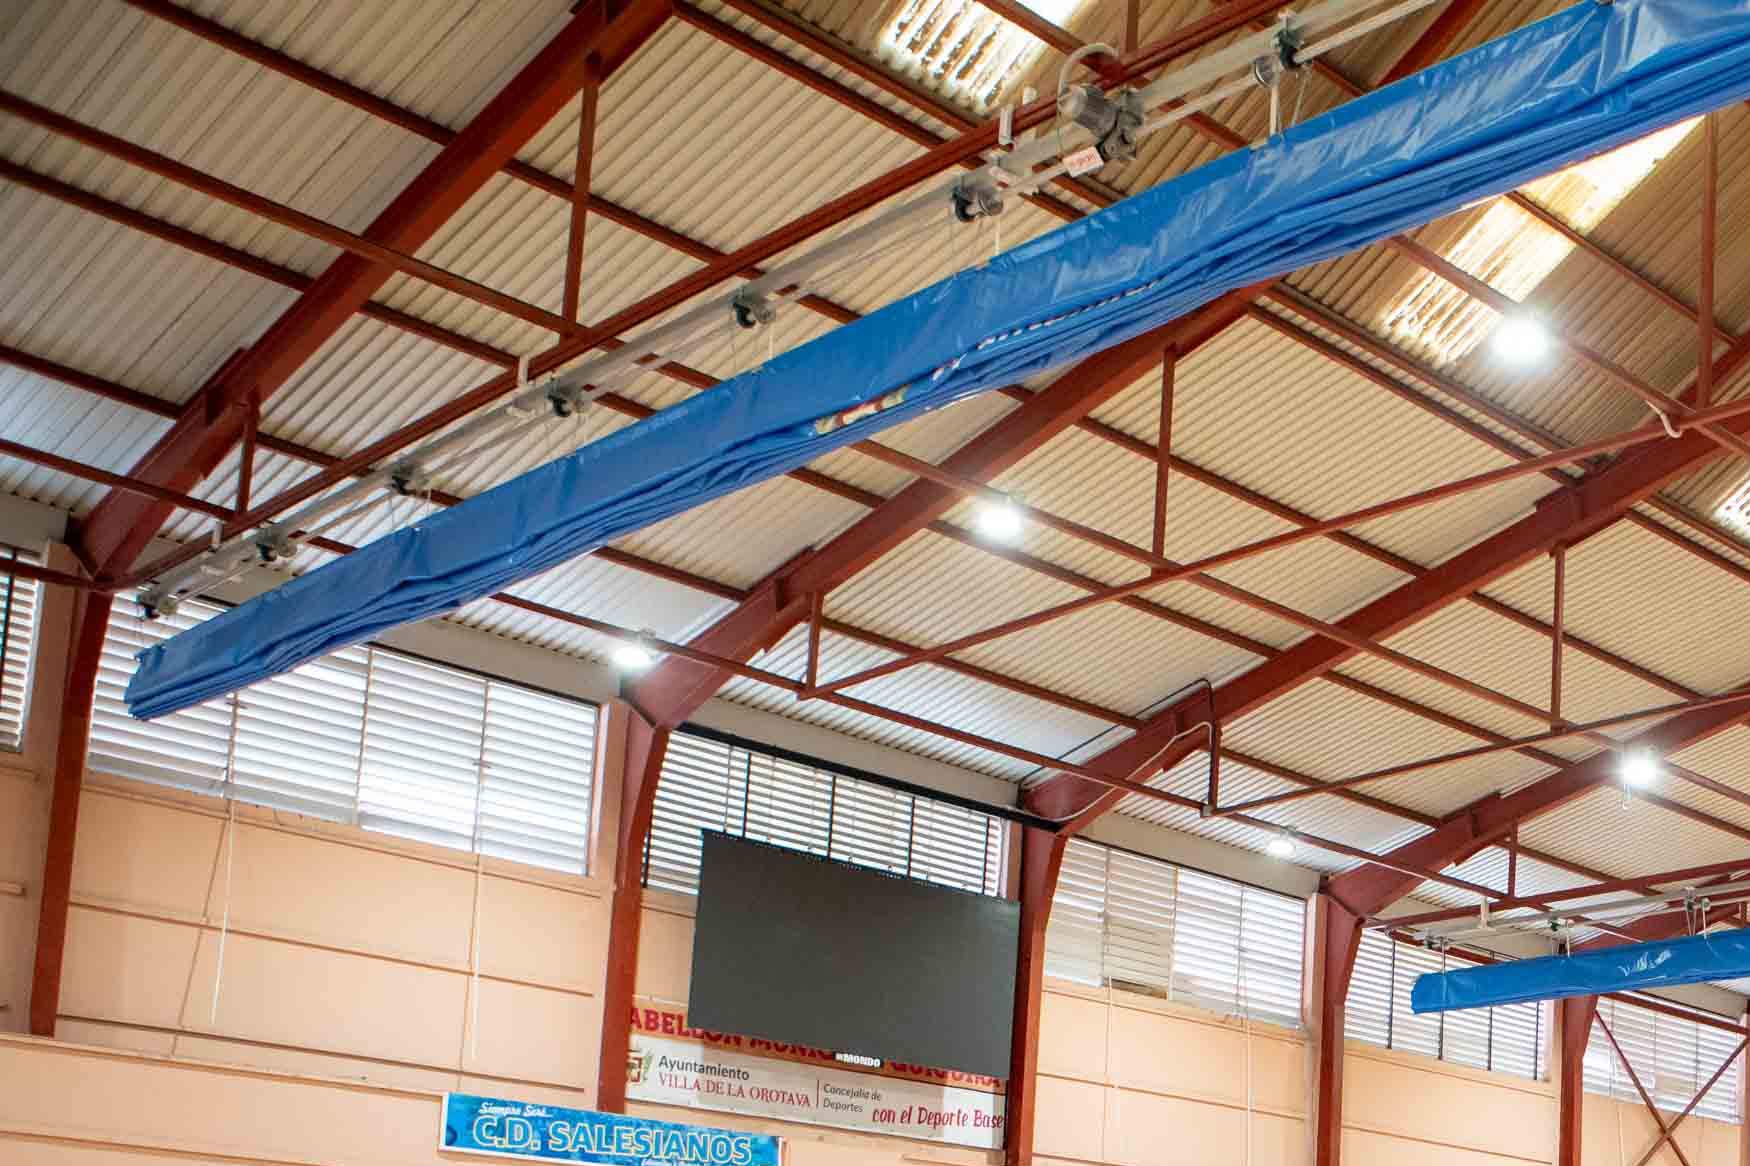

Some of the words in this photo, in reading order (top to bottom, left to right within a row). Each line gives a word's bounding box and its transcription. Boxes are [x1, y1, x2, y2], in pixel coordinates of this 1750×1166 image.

[658, 1055, 750, 1081] Ayuntamiento
[657, 1072, 701, 1092] VILLA
[705, 1079, 724, 1095] DE
[726, 1081, 746, 1098] LA
[749, 1086, 811, 1107] OROTAVA
[823, 1098, 863, 1113] Deportes
[872, 1108, 896, 1123] con
[900, 1106, 913, 1124] el
[917, 1106, 969, 1130] Deporte
[973, 1110, 1004, 1129] Base
[473, 1115, 541, 1150] C.D.
[549, 1121, 752, 1165] SALESIANOS
